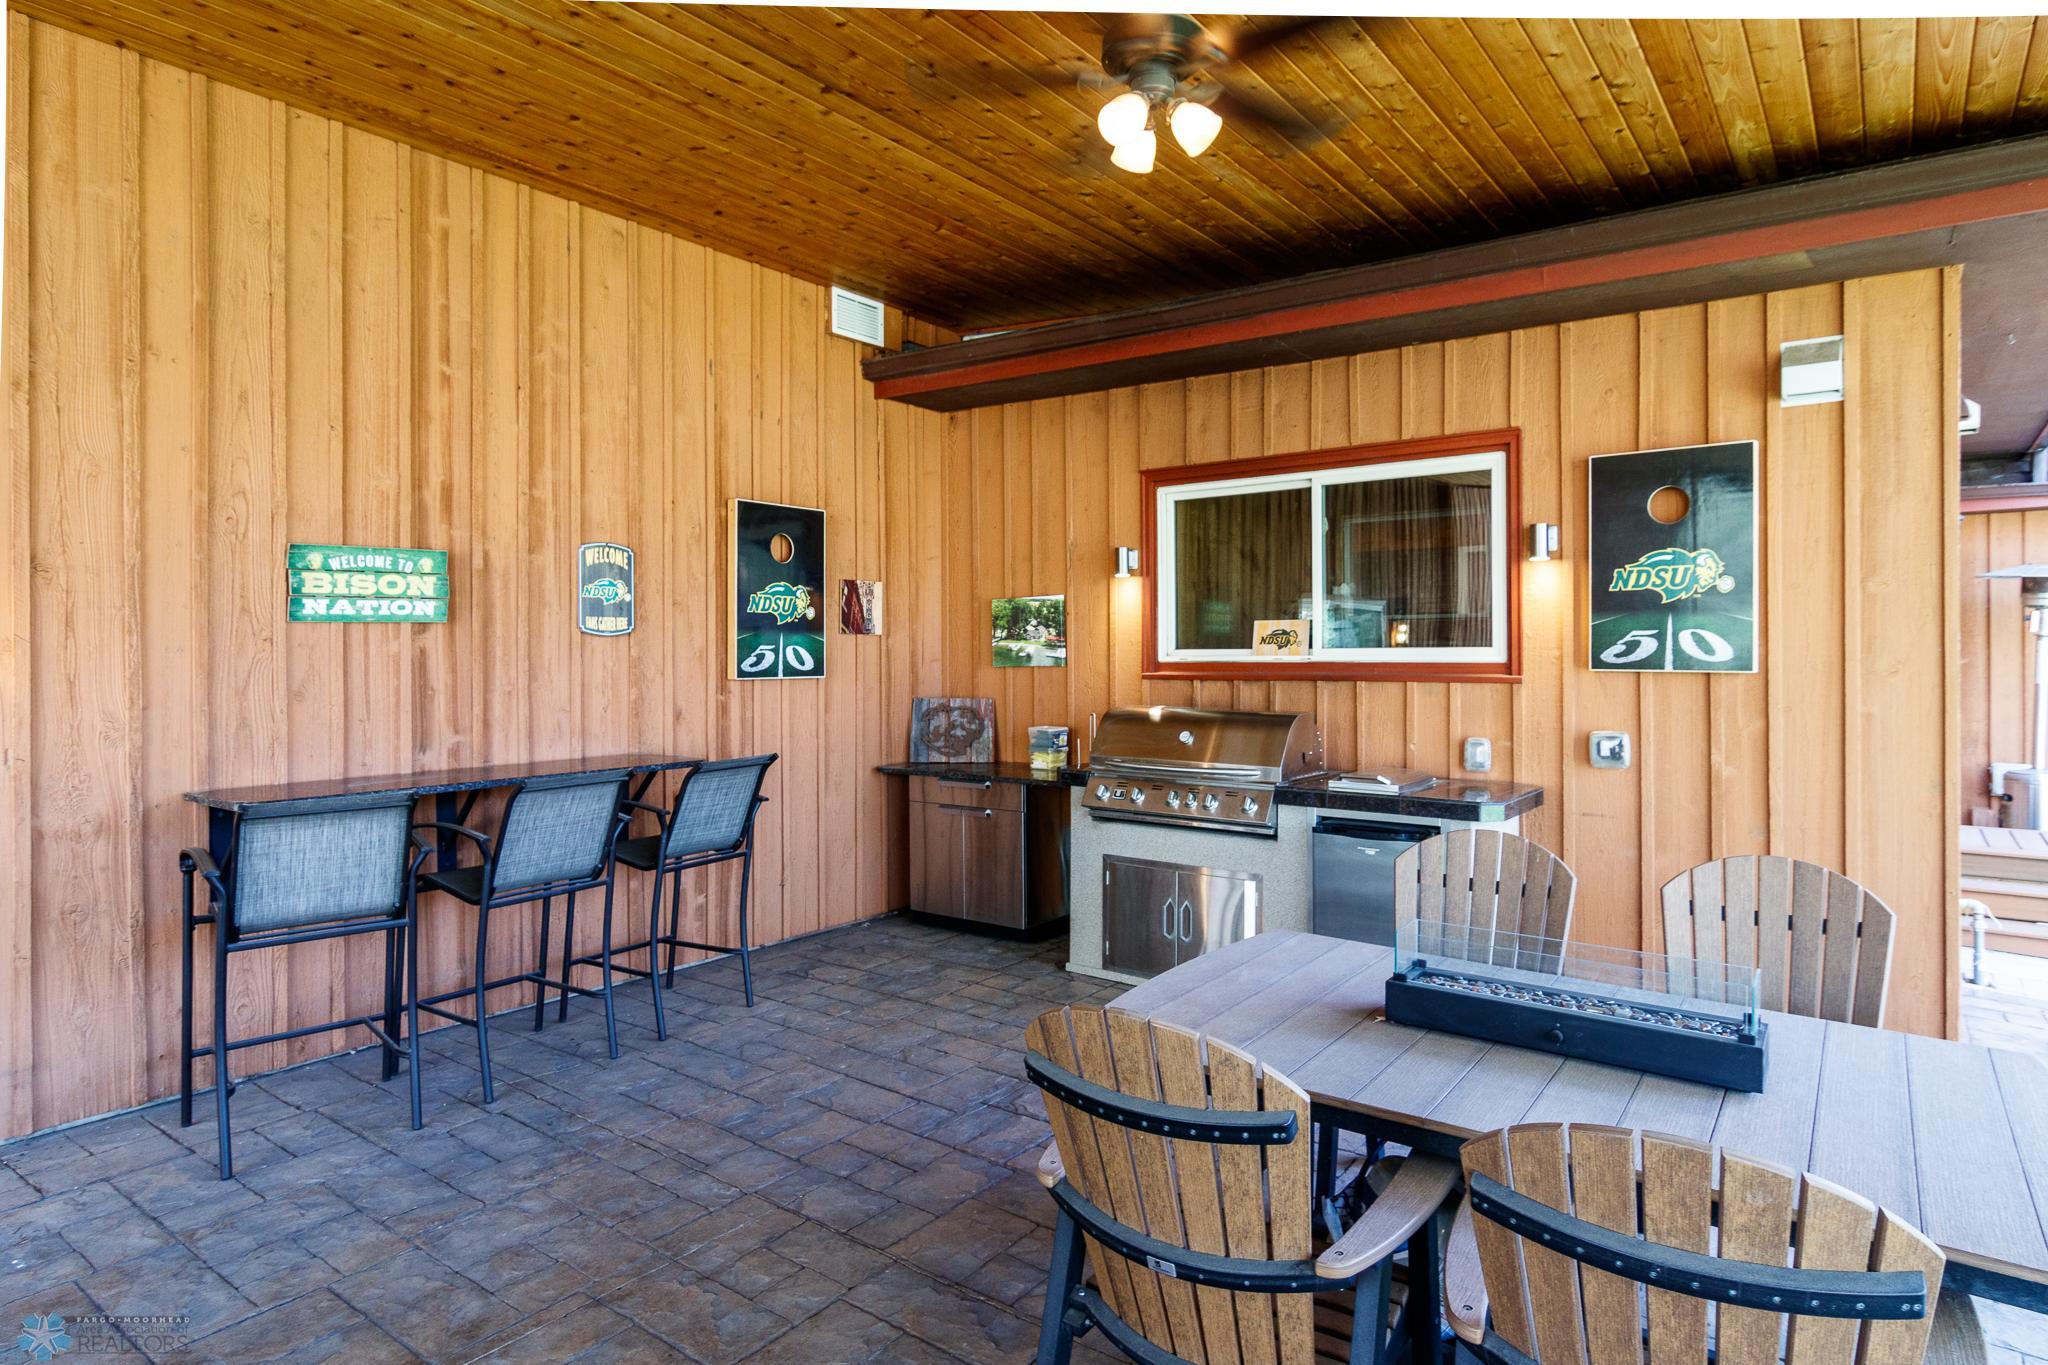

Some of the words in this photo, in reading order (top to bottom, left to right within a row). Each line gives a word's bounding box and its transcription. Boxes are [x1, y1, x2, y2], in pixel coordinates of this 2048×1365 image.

[328, 555, 393, 570] WELCOME
[398, 559, 414, 573] TO
[585, 547, 629, 570] WELCOME
[301, 572, 437, 596] BISON
[1609, 567, 1694, 591] NDSU
[582, 586, 615, 598] NDSU
[302, 599, 436, 616] NATION
[747, 594, 794, 614] NDSU
[1260, 636, 1288, 645] NDSU
